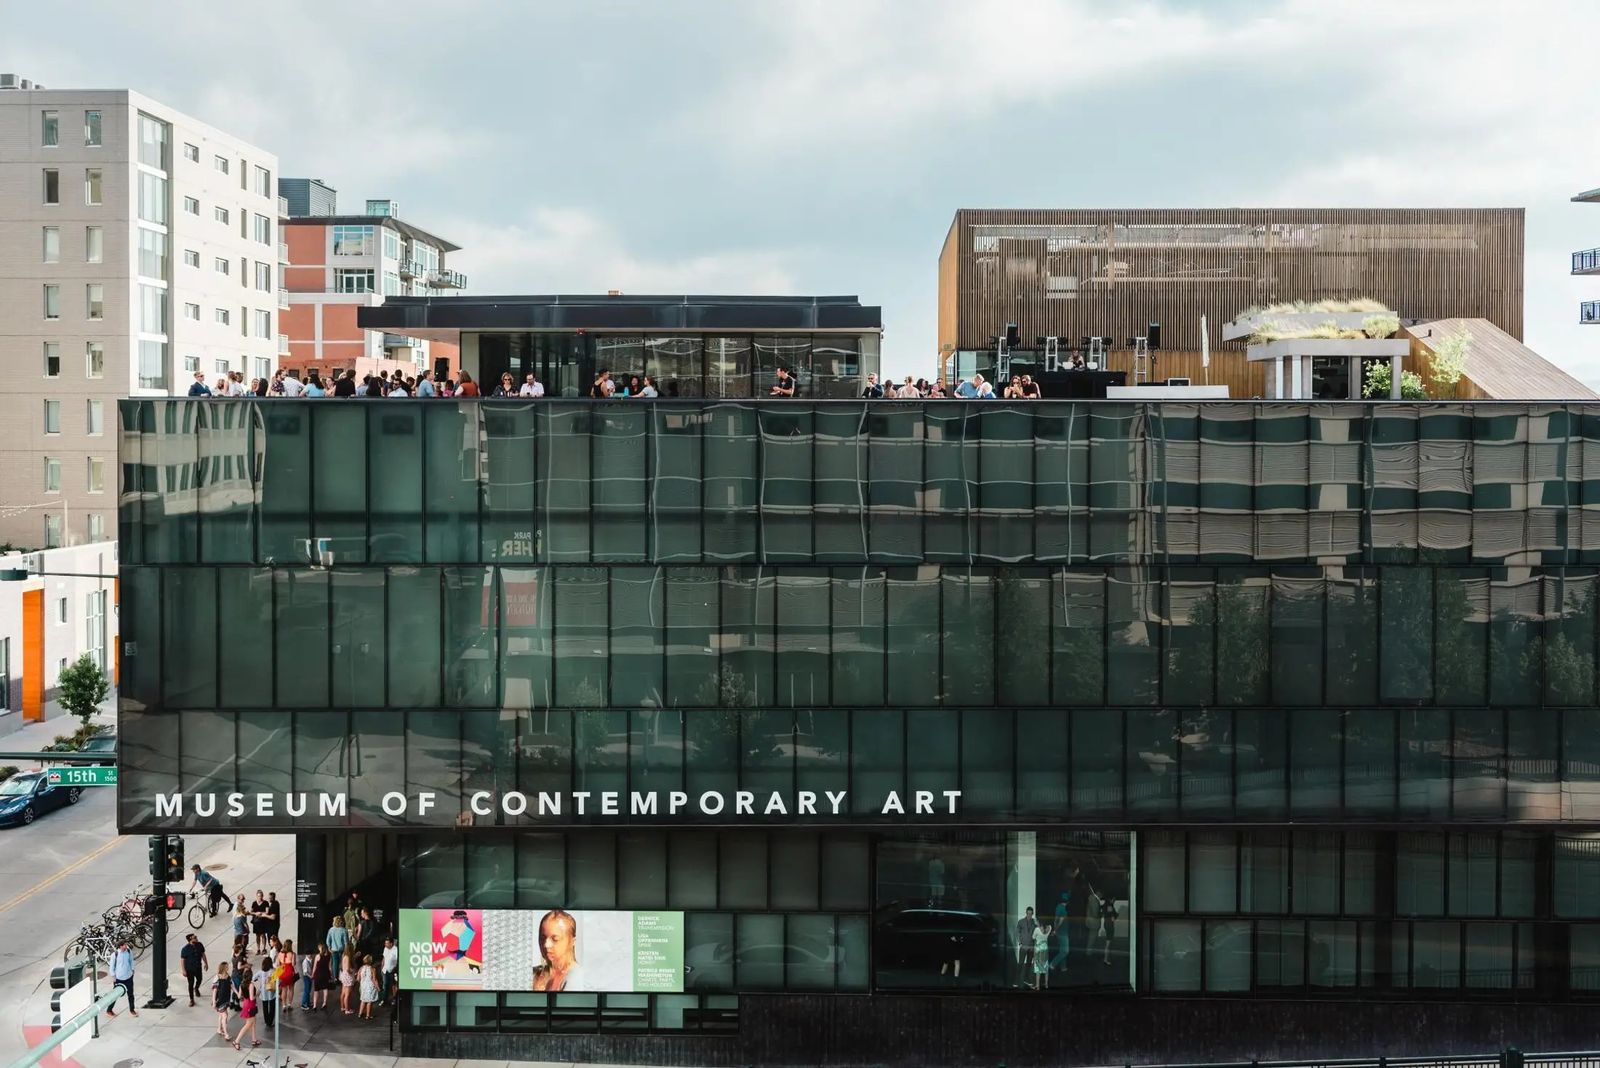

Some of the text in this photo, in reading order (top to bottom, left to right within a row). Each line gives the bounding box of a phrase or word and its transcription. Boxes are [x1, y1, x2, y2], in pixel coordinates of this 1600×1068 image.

[67, 770, 97, 782] 15th
[156, 791, 961, 816] MUSEUM OF CONTEMPORARY ART
[409, 942, 447, 954] NOW
[410, 954, 433, 966] ON
[410, 967, 446, 979] VIEW
